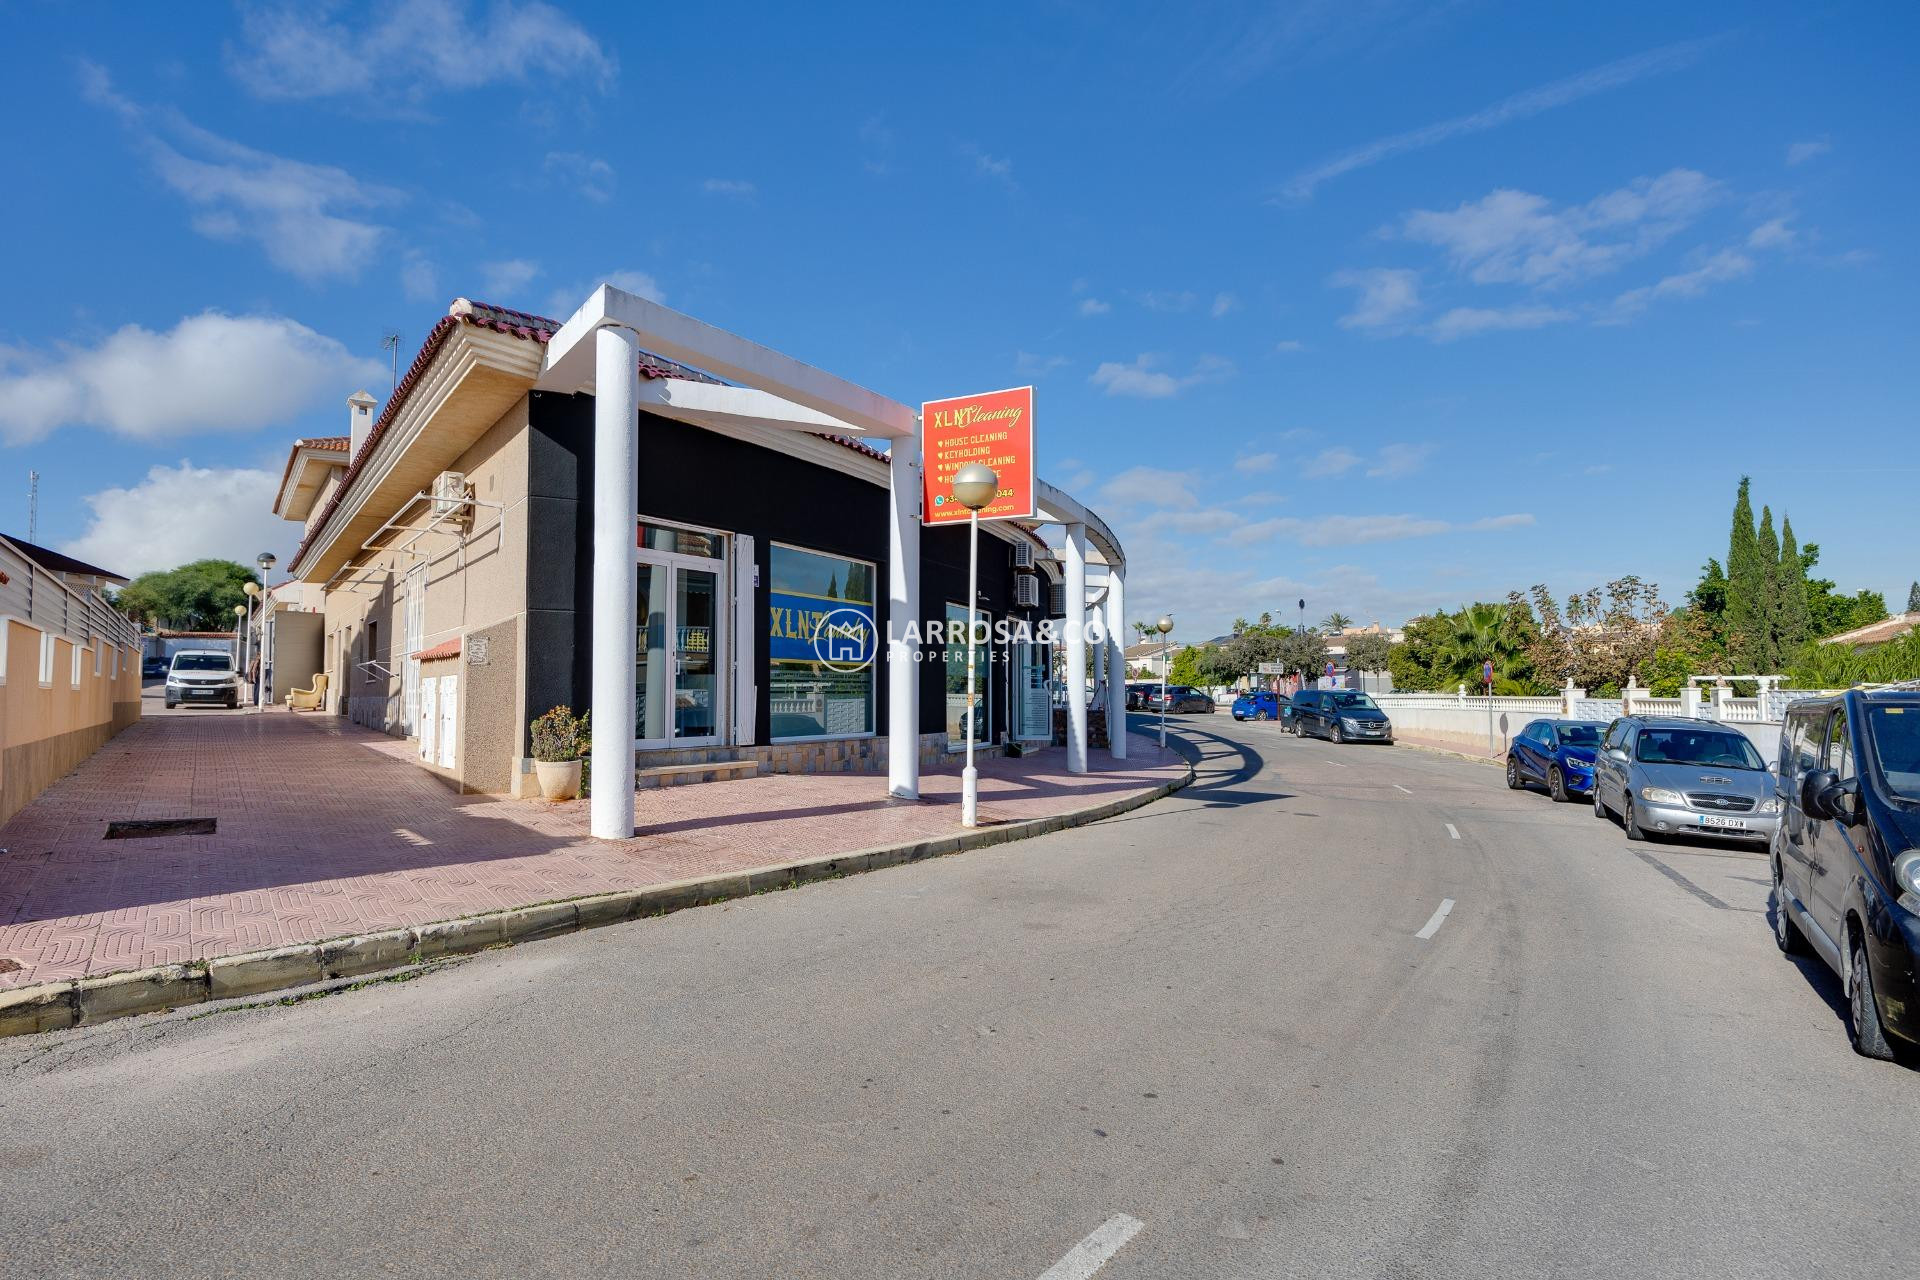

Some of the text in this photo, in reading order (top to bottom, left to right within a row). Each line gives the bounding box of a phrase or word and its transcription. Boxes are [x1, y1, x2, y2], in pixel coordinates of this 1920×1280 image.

[959, 405, 1023, 428] Cleaning
[944, 432, 1008, 448] HOUSE CLEANING
[944, 446, 990, 459] KEYHOLDING
[935, 505, 1015, 517] www.xlntcaning.com
[770, 606, 823, 640] XLNT
